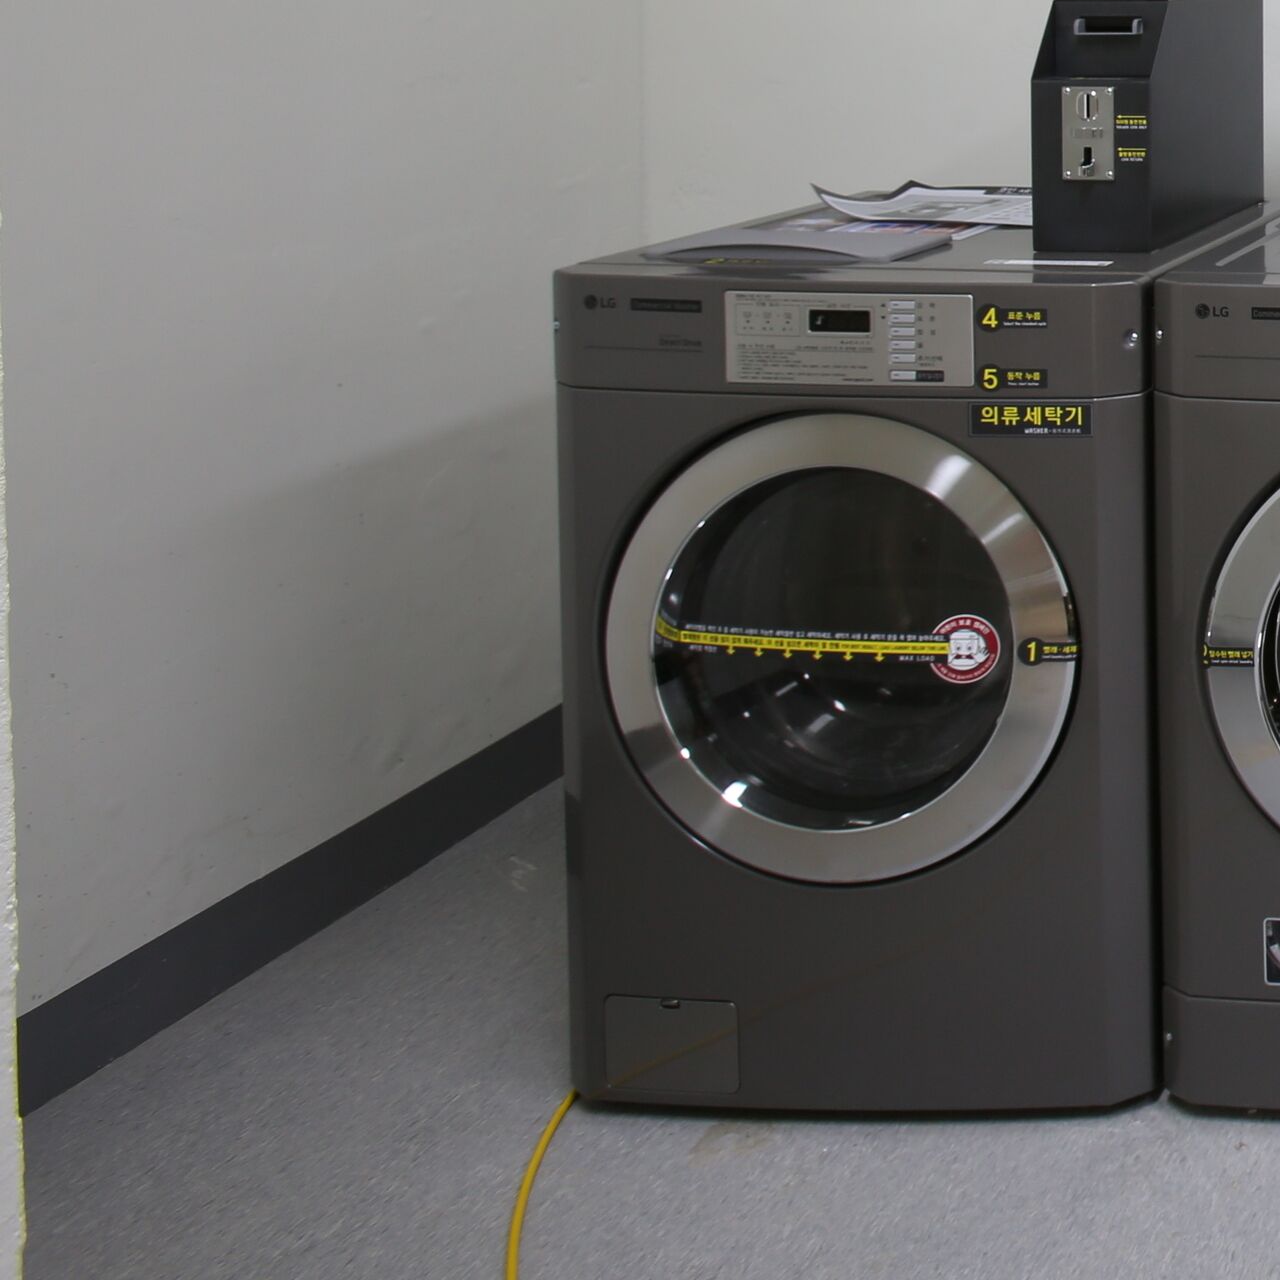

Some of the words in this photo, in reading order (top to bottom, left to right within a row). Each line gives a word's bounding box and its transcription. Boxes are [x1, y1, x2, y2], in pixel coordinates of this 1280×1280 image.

[600, 297, 617, 309] LG
[1212, 306, 1229, 318] LG
[982, 307, 998, 328] 4
[983, 368, 998, 390] 5
[980, 406, 1082, 426] 의류세탁기
[1027, 641, 1036, 662] 1
